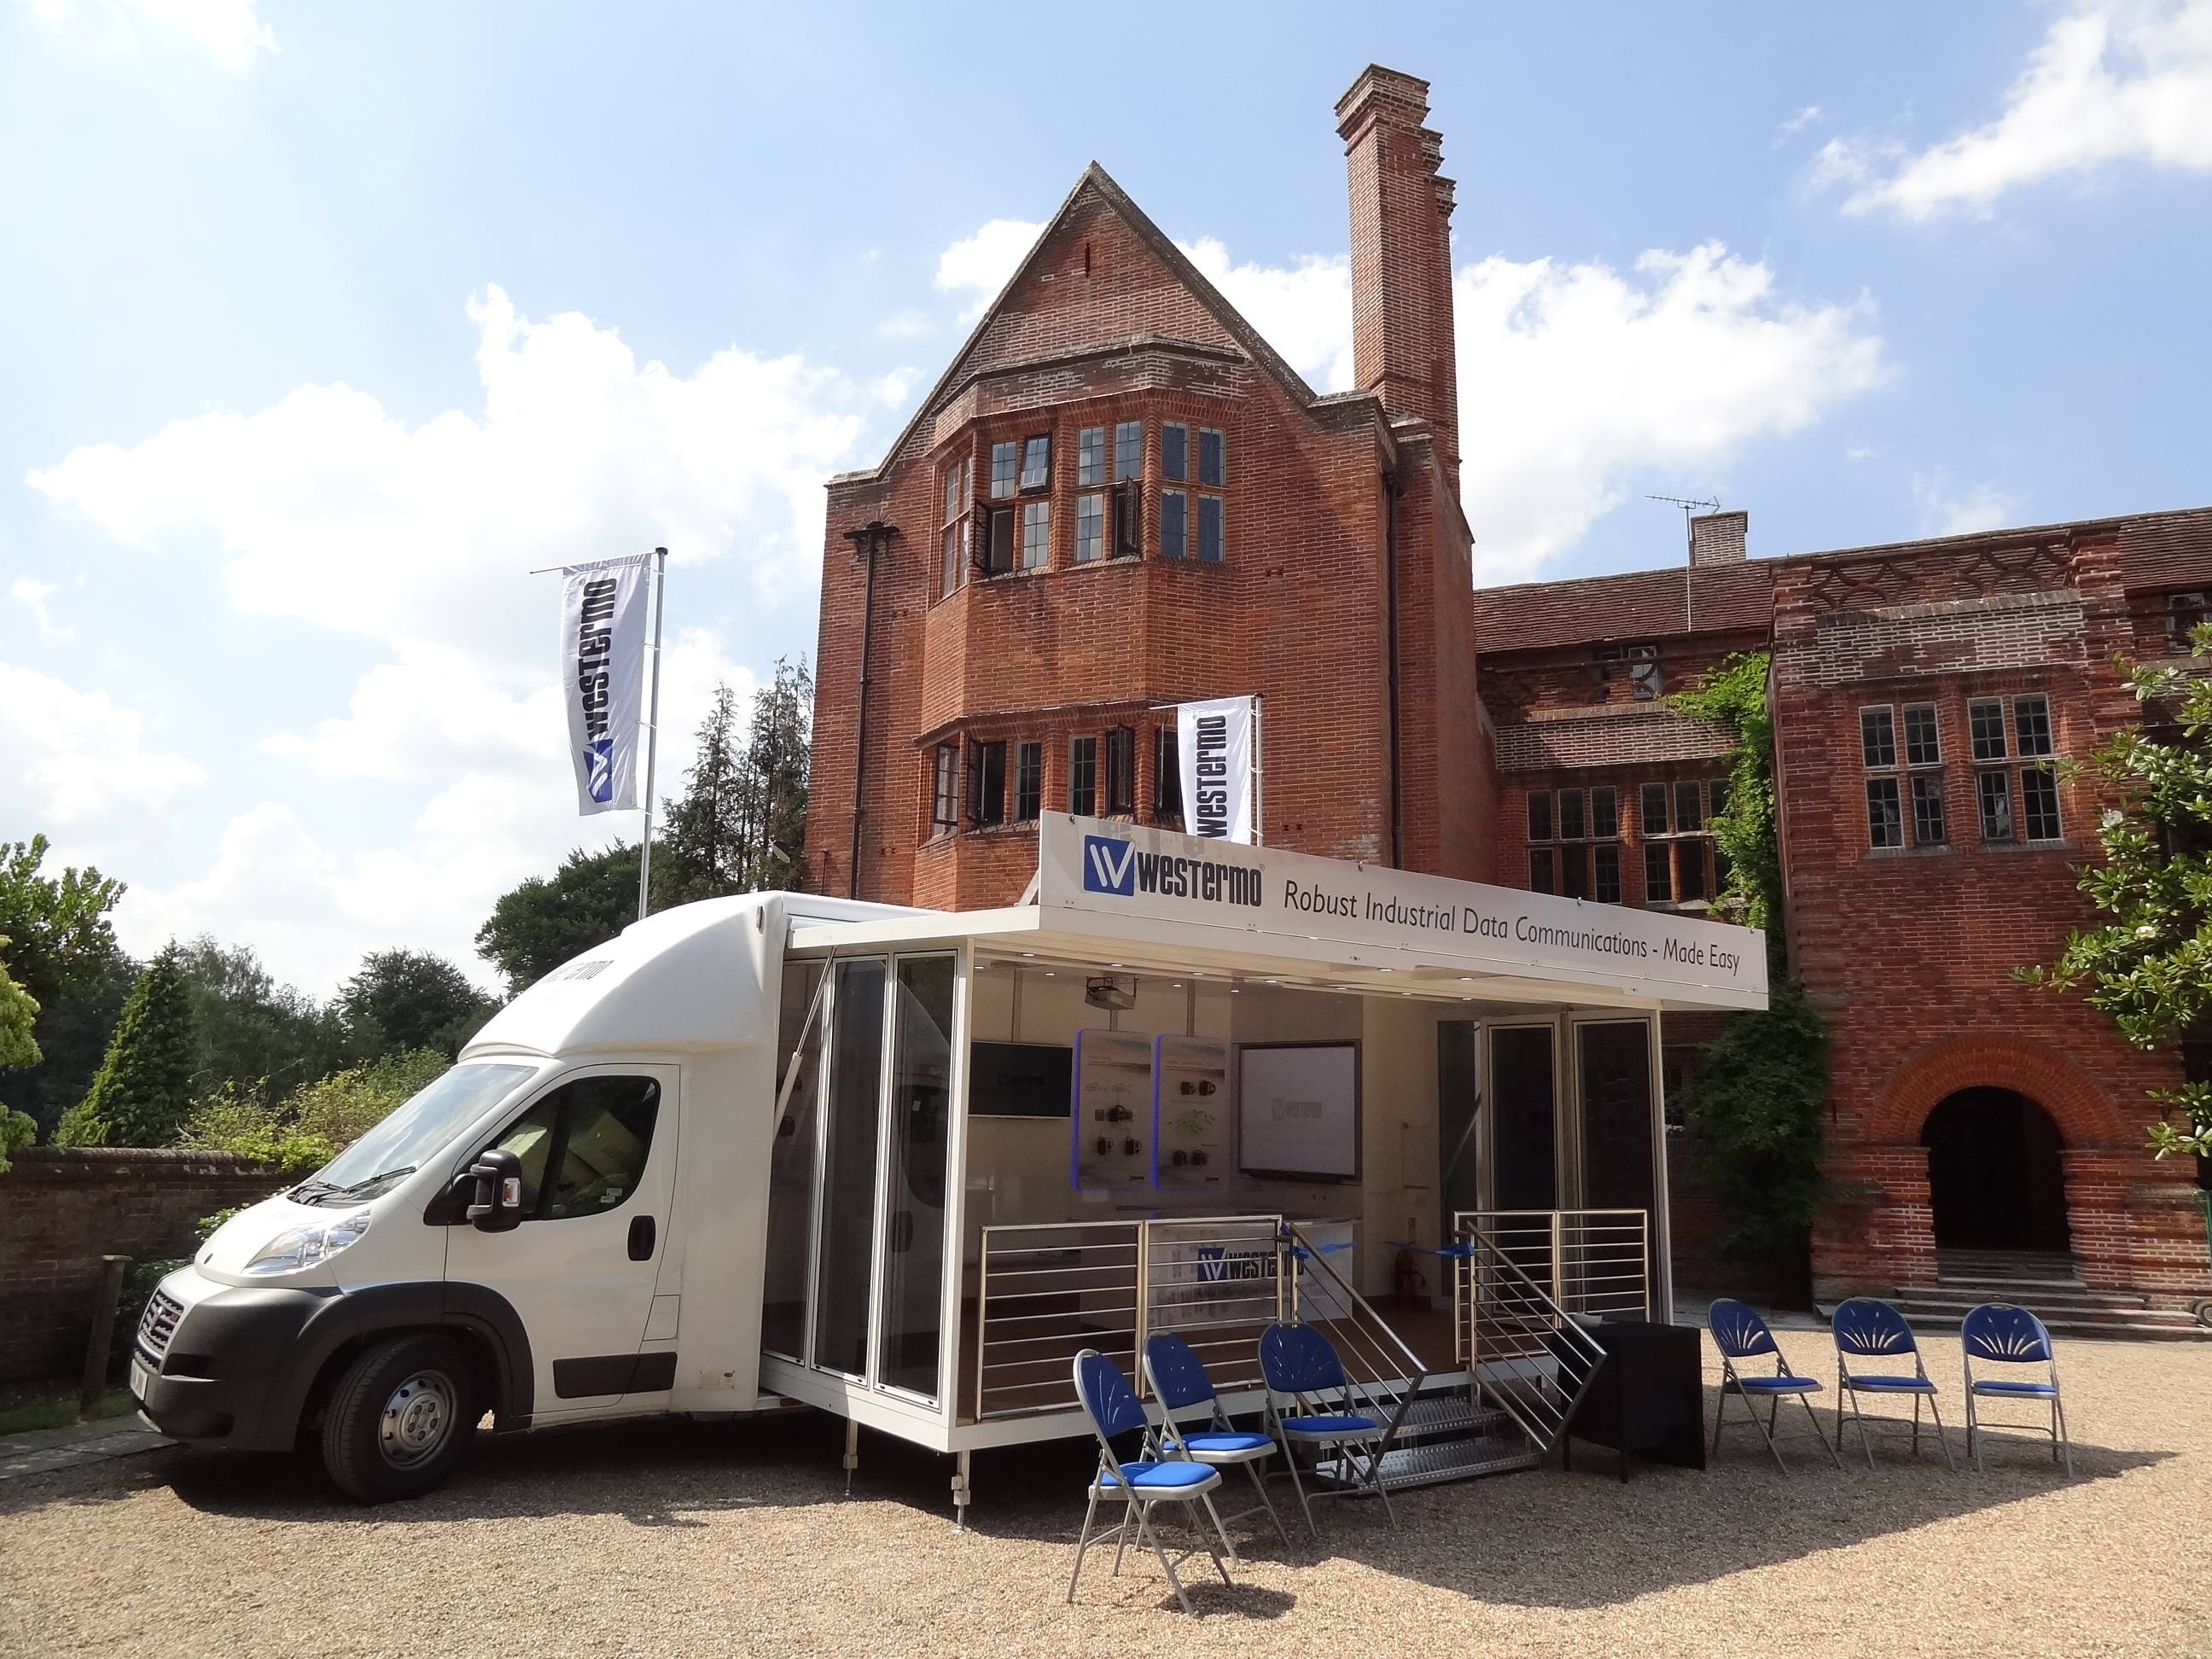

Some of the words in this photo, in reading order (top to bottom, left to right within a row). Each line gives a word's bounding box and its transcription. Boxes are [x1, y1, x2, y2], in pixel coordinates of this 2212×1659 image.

[1284, 879, 1358, 918] Robust
[1365, 892, 1455, 932] Industrial
[1463, 907, 1508, 939] Data
[1516, 916, 1647, 958] Communications
[1663, 937, 1704, 965] Made
[1709, 944, 1740, 977] Easy
